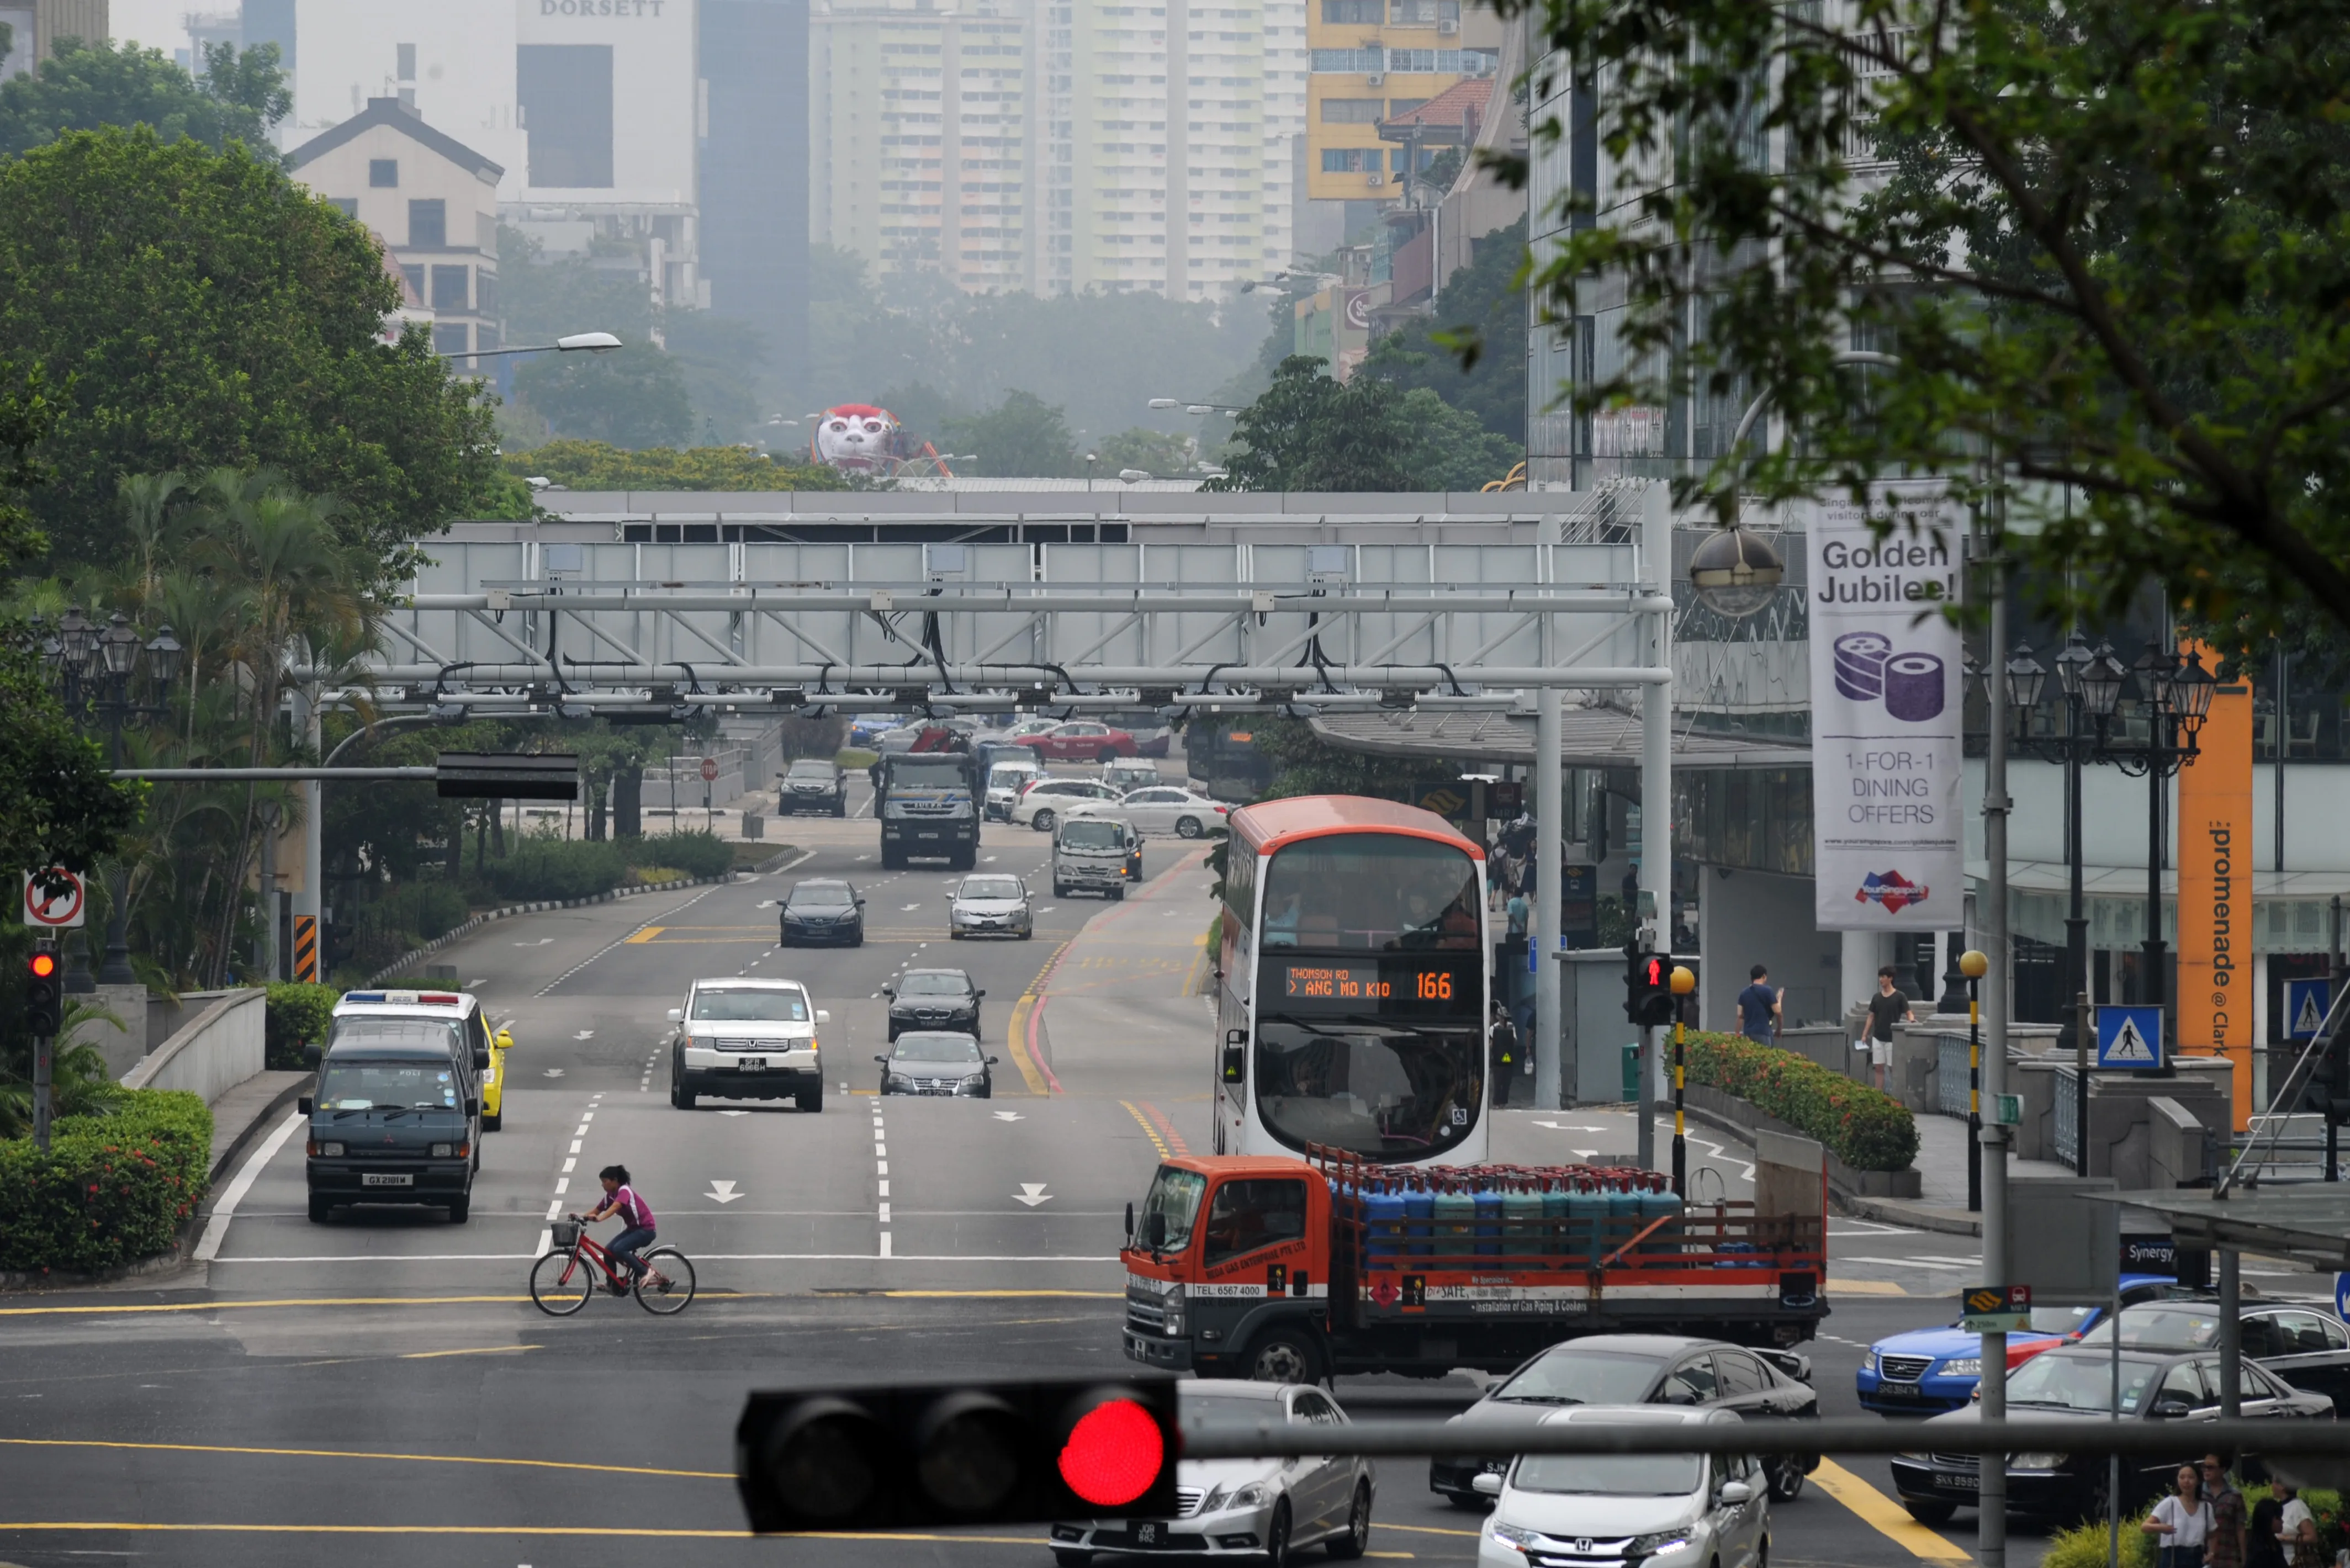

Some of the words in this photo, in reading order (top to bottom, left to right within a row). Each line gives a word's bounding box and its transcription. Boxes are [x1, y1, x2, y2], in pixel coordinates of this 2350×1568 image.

[541, 0, 663, 17] DORSETT
[1820, 497, 1882, 509] Singare
[1920, 510, 1940, 518] our
[1823, 539, 1949, 569] Golden
[1818, 573, 1955, 603] Jubilee!
[701, 765, 717, 775] STOP
[1845, 751, 1933, 771] 1-FOR-1
[1853, 778, 1929, 797] DINING
[1849, 804, 1934, 824] OFFERS
[2209, 829, 2235, 987] promenade
[1290, 968, 1332, 980] THOMSON
[1335, 970, 1348, 980] RD
[1305, 980, 1332, 996] ANG
[1340, 981, 1359, 997] MO
[1366, 982, 1391, 997] KIO
[1417, 972, 1451, 999] 166
[2211, 992, 2226, 1007] @
[1241, 1250, 1279, 1269] ENTERPRISE
[1280, 1246, 1293, 1257] PTE
[2129, 1244, 2174, 1263] Synergy
[1197, 1286, 1215, 1295] TEL:
[1218, 1286, 1236, 1295] 6567
[1240, 1286, 1260, 1295] 4000
[1476, 1301, 1511, 1312] Installation
[1512, 1302, 1520, 1312] of
[1521, 1301, 1533, 1311] Gas
[1534, 1301, 1553, 1313] Piping
[1555, 1301, 1560, 1311] &
[1562, 1301, 1587, 1311] Cookers
